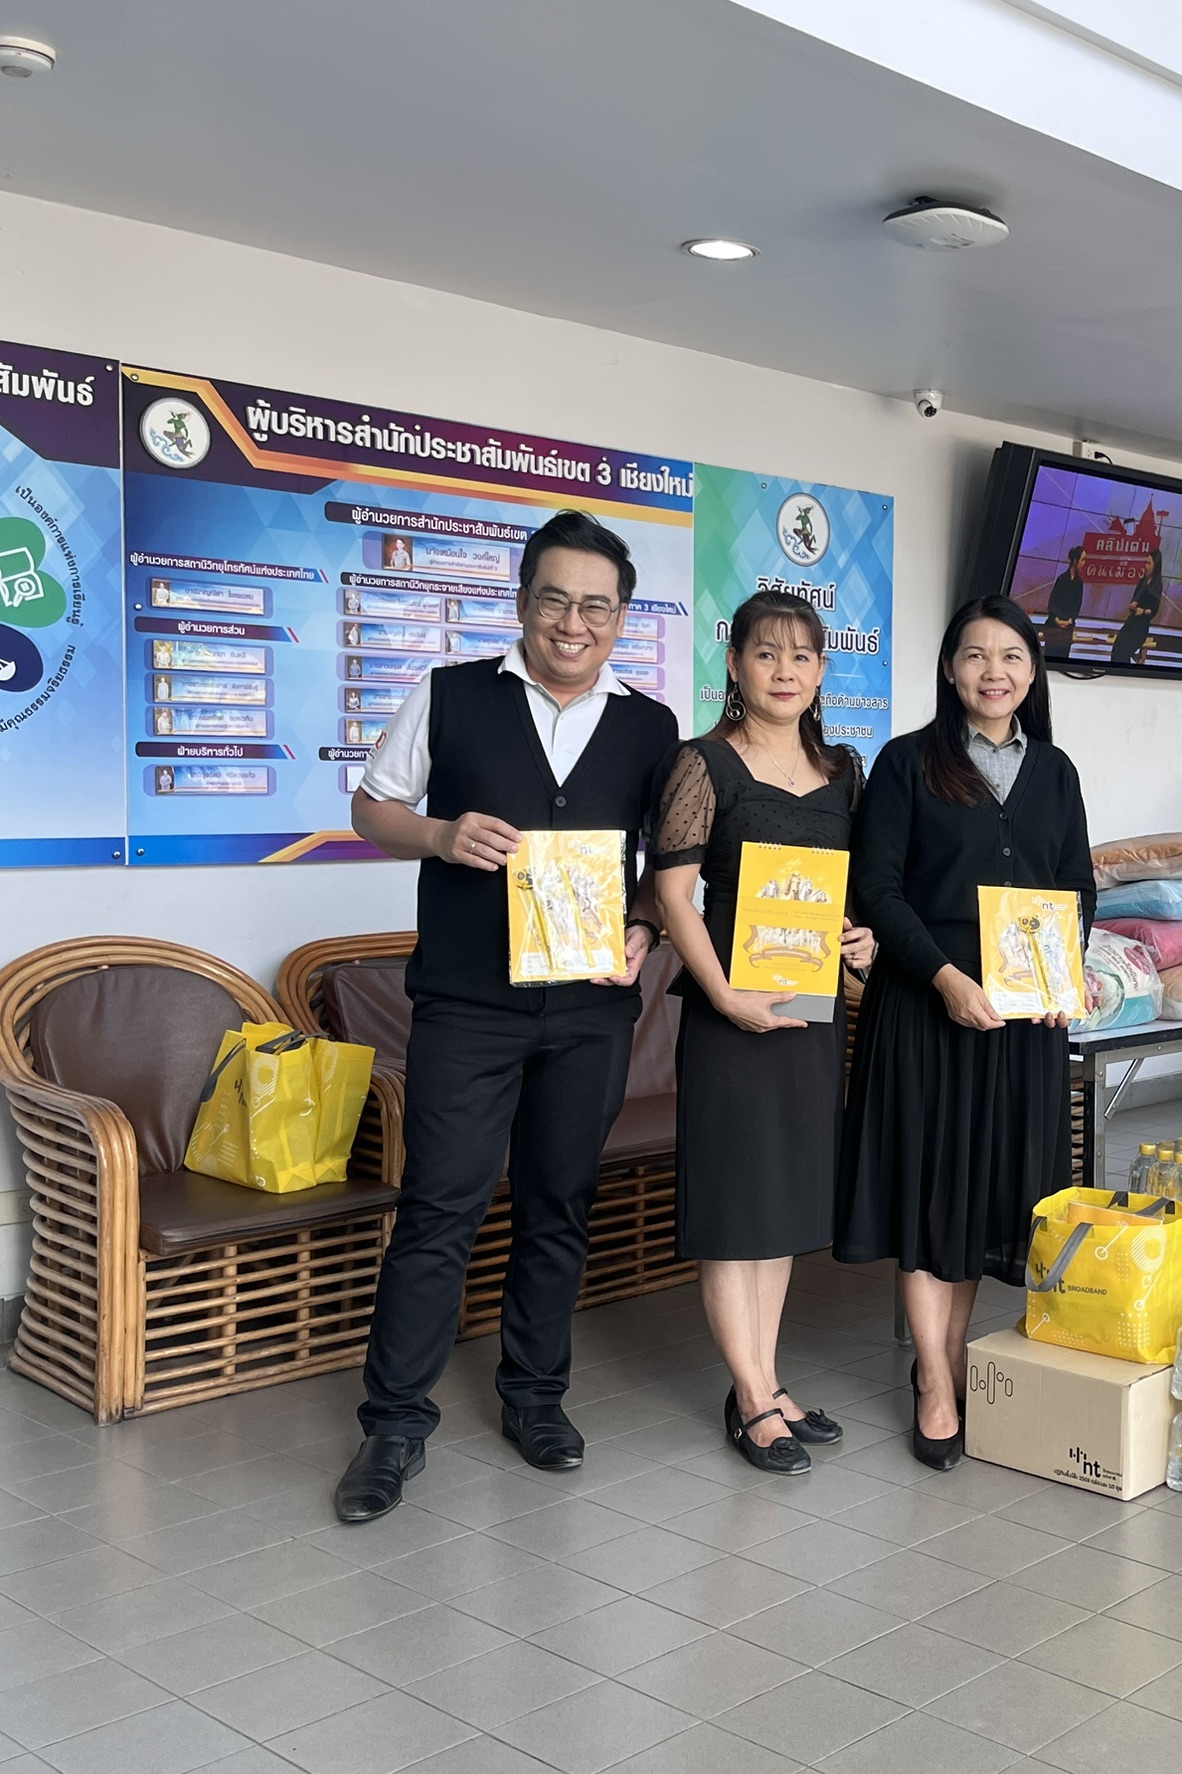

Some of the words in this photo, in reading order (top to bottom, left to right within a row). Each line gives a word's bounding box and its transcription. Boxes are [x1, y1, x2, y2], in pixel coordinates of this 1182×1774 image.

[246, 399, 591, 483] ผู้บริหารสำนักประชาสัมพันธ์เขต
[596, 462, 612, 486] 3
[349, 573, 518, 599] ผู้อำนวยการสถานีวิทยุกระจายเสียงแห่งประเทศไท
[328, 747, 370, 761] ผู้อำนวยกา
[1067, 1284, 1108, 1296] BROADBAND
[1083, 1460, 1102, 1478] nt
